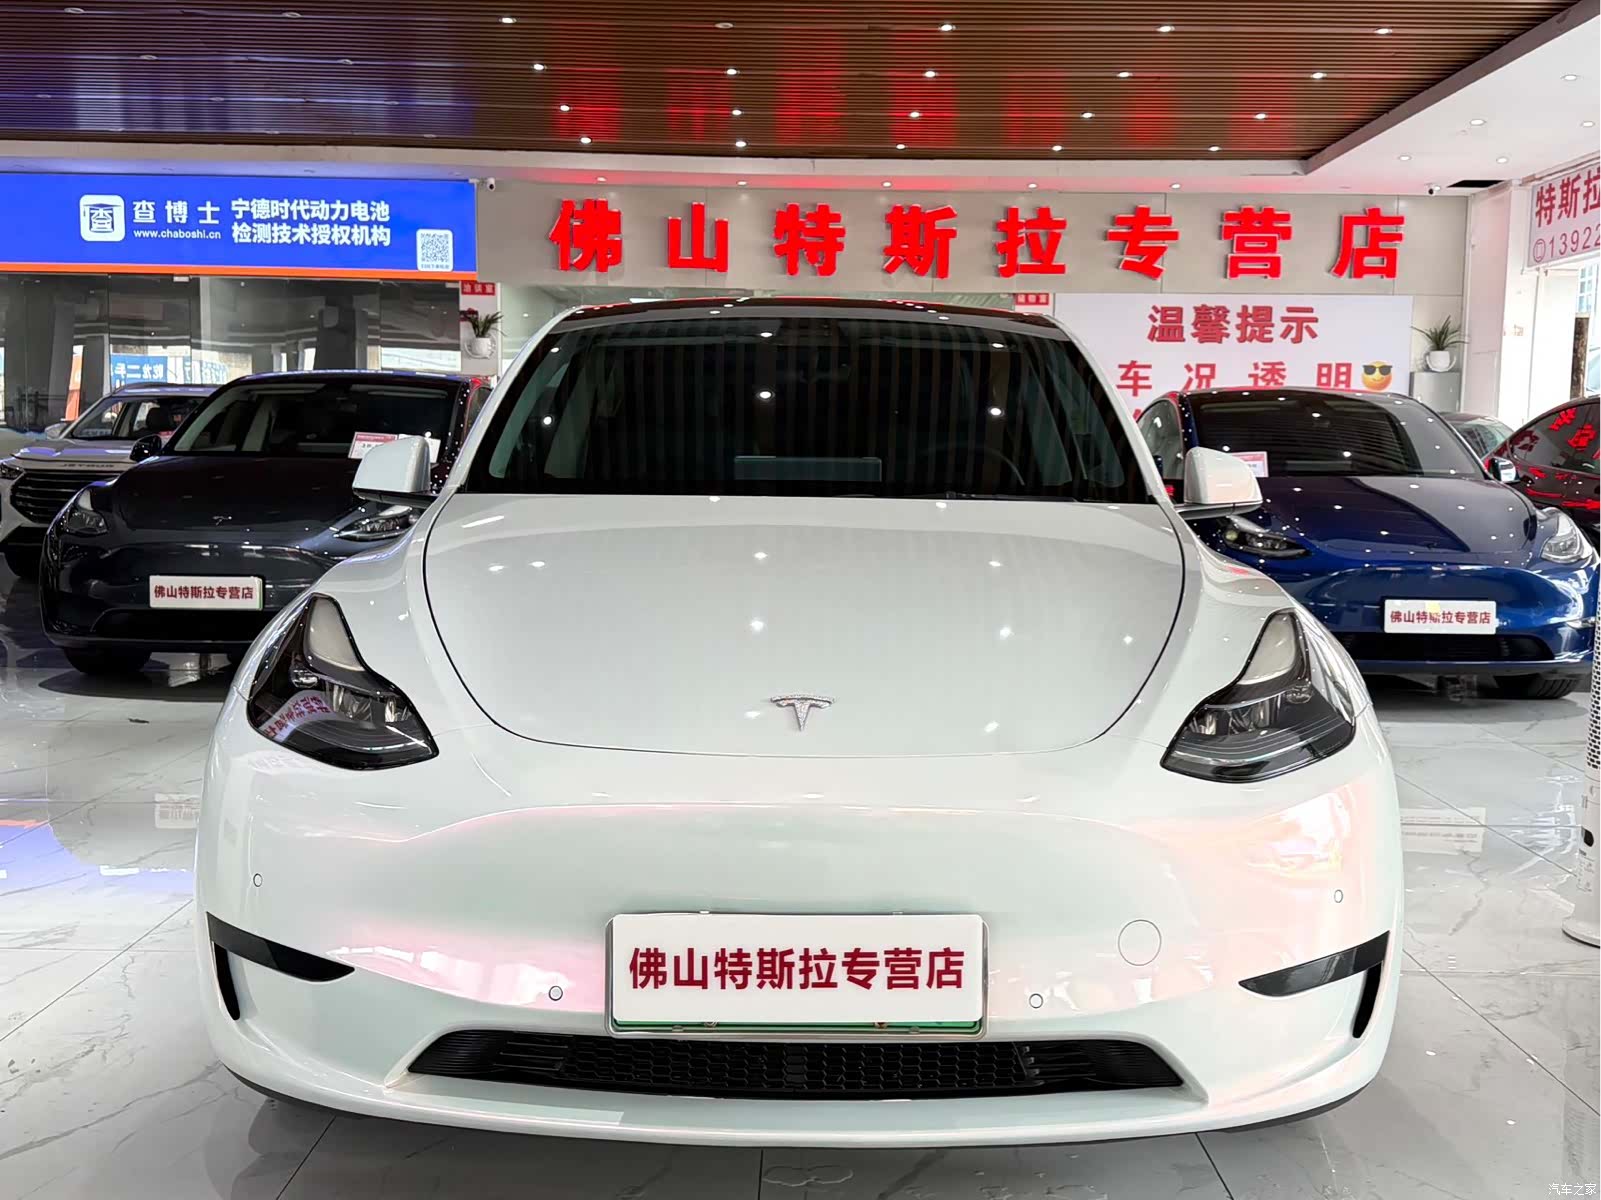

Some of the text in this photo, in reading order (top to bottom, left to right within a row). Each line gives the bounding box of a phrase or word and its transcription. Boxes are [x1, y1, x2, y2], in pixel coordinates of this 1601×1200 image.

[132, 200, 221, 224] 查博士
[231, 198, 390, 222] 宁德时代动力电池
[133, 229, 221, 240] www.chaboshi.cn
[231, 222, 391, 247] 检测技术授权机构
[550, 199, 1405, 279] 佛山特斯拉专营店
[1147, 304, 1319, 344] 温馨提示
[1116, 360, 1352, 397] 车况透明
[154, 585, 253, 600] 佛山特斯拉专营店
[1390, 610, 1491, 625] 佛山特斯拉专营店
[629, 948, 965, 990] 佛山特斯拉专营店
